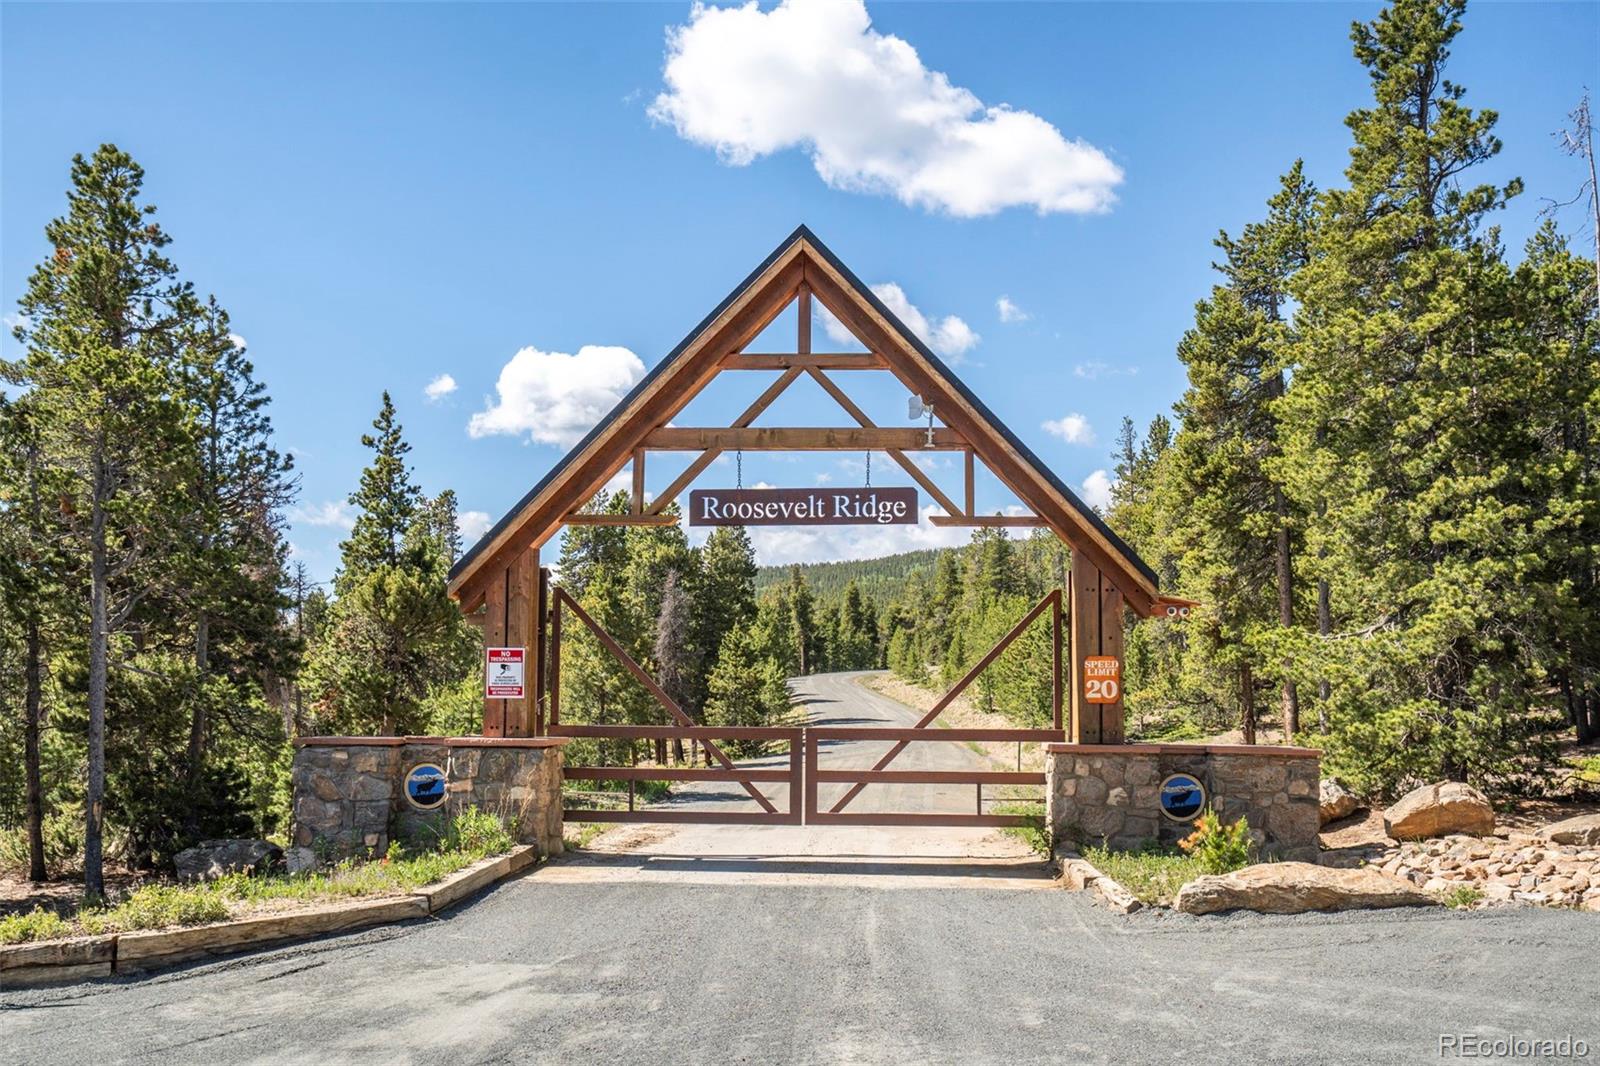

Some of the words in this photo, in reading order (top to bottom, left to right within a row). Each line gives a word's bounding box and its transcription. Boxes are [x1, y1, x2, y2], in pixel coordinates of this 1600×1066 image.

[702, 495, 825, 519] Roosevelt
[833, 494, 907, 523] Ridge
[1084, 660, 1119, 669] SPEED
[1087, 668, 1118, 676] LIMIT
[1086, 679, 1118, 699] 20
